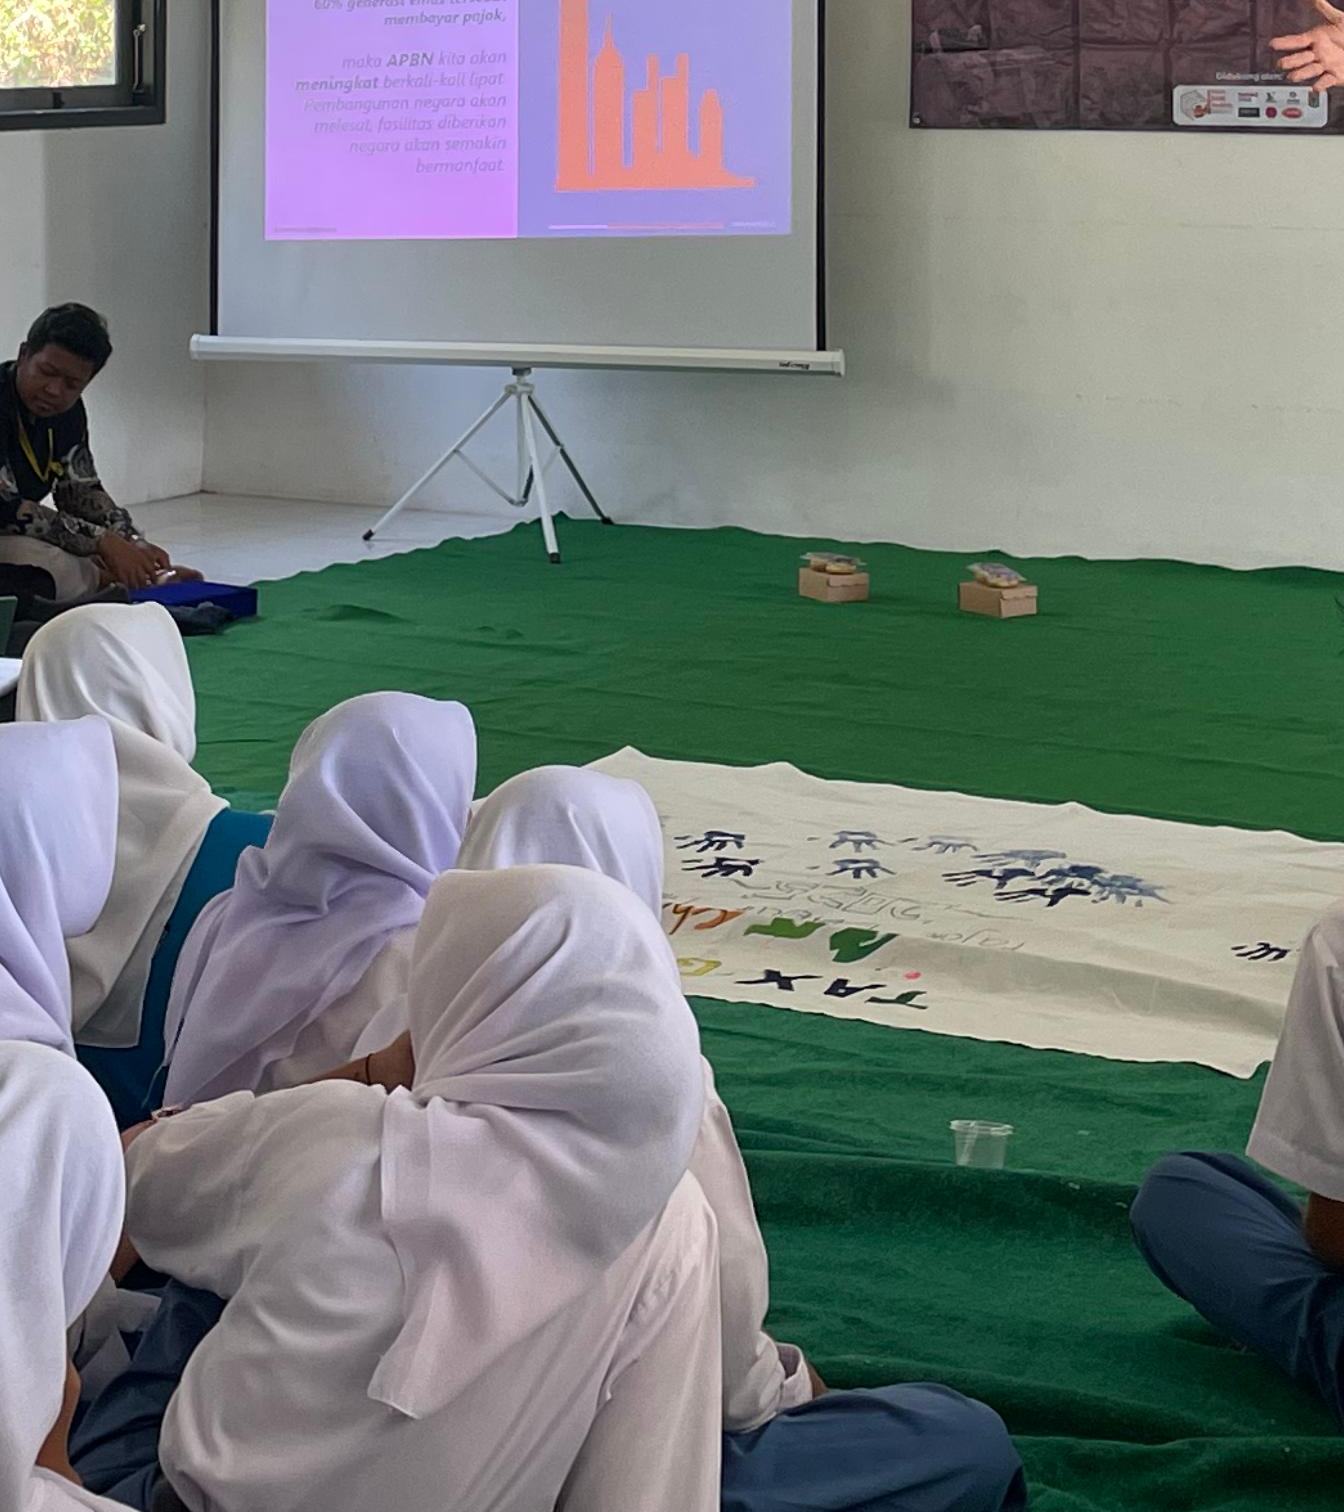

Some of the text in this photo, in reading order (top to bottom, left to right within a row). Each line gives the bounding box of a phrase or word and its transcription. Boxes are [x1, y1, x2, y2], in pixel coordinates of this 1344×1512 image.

[384, 9, 507, 26] membayar pajak,
[342, 49, 507, 69] maka APBN kita akan
[295, 76, 379, 94] meningkat
[414, 98, 465, 113] negara
[470, 94, 507, 108] akan
[349, 136, 507, 156] negara akan semakin
[734, 968, 928, 1010] TAX
